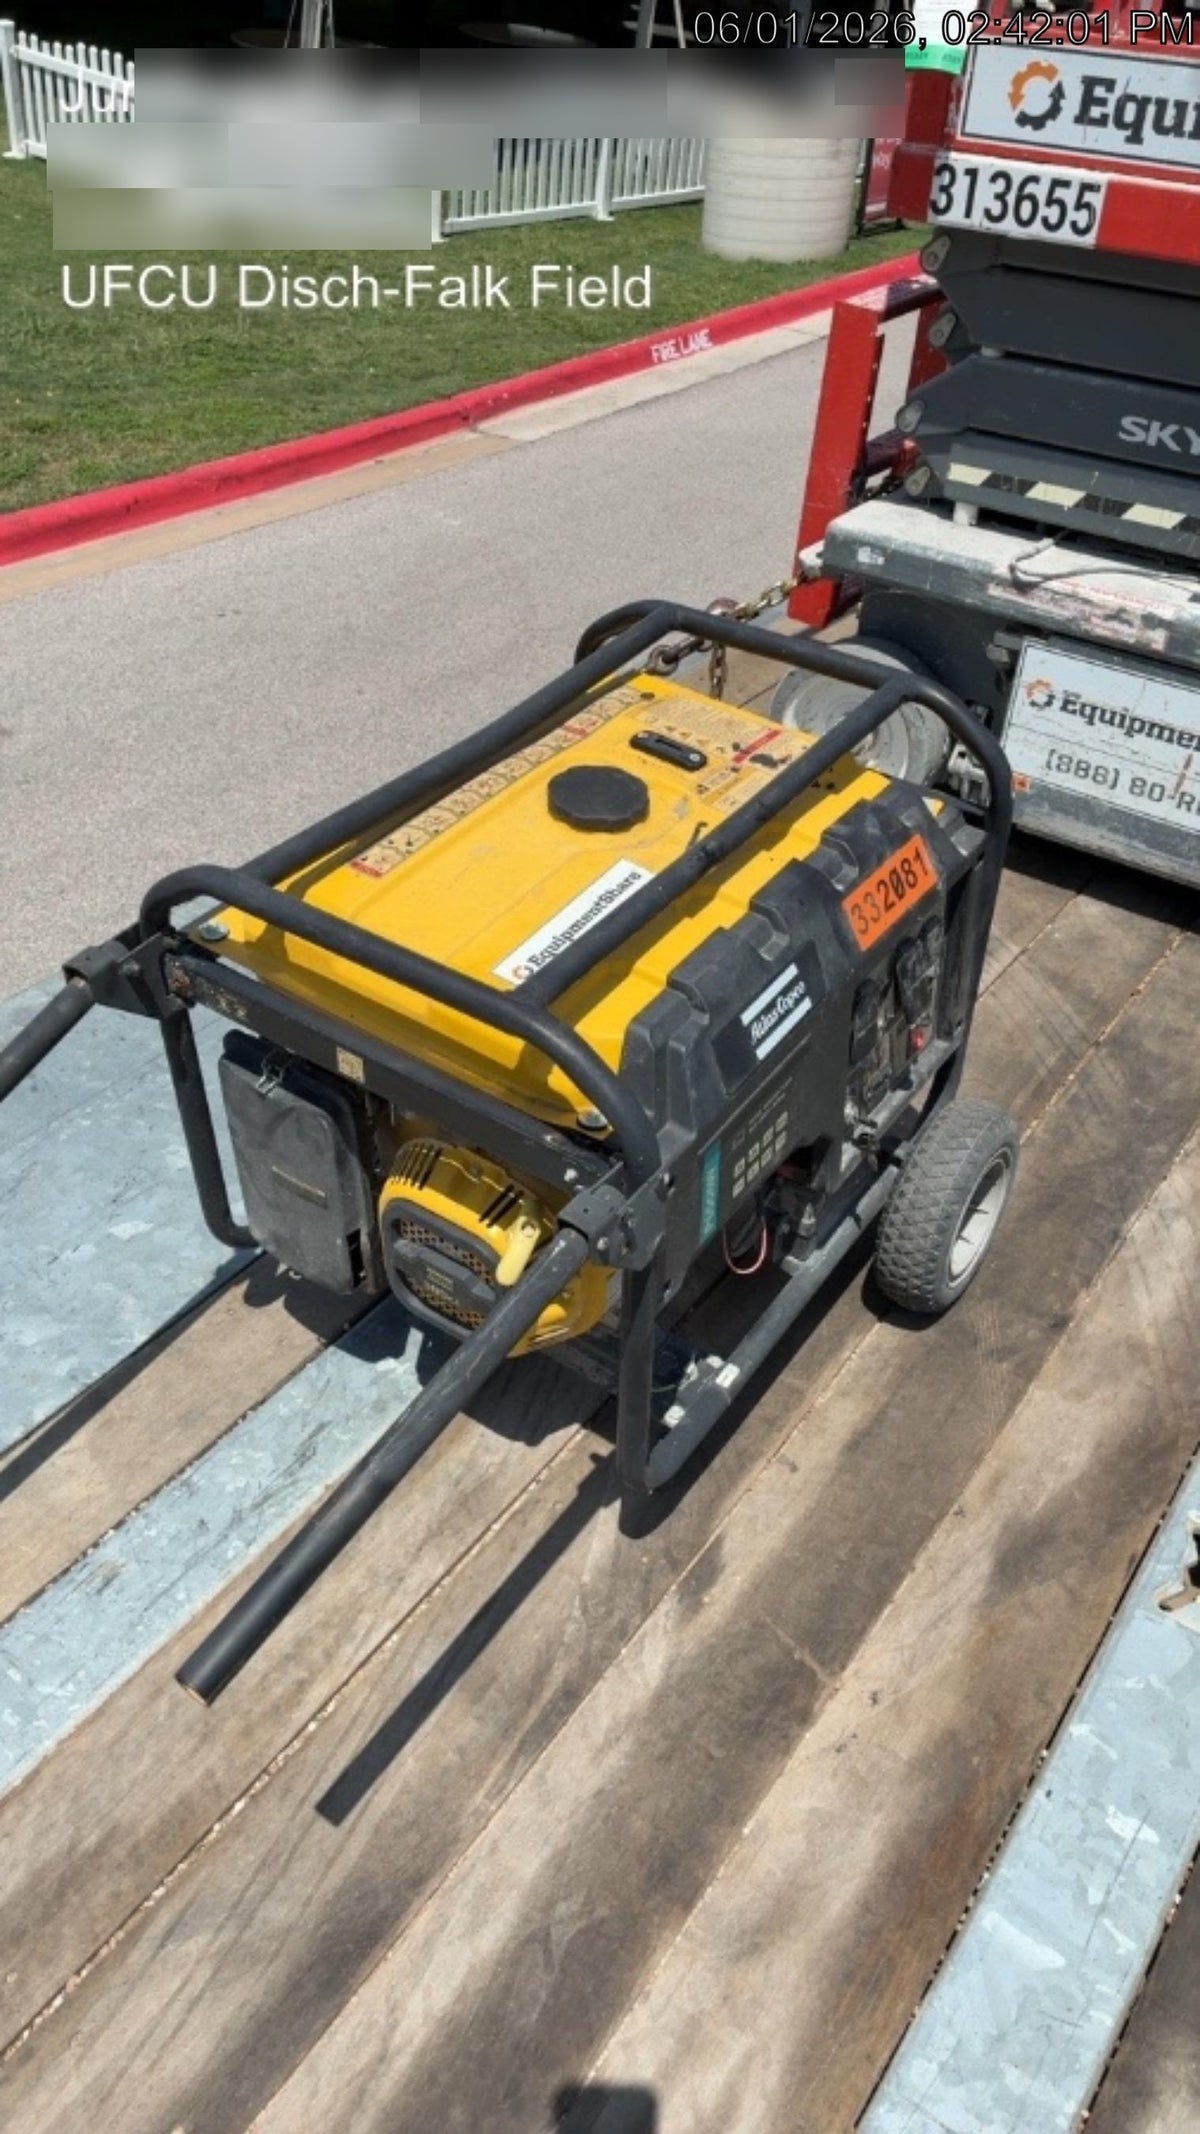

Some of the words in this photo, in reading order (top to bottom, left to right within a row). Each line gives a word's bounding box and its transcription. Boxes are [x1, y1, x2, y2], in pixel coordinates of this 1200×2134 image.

[931, 163, 1101, 237] 313655
[650, 339, 681, 363] FIRE
[678, 329, 713, 354] LANE
[1046, 749, 1120, 790] (888)
[1129, 776, 1200, 816] 80-R
[528, 871, 642, 968] EquipmentShare
[851, 846, 929, 936] 332081
